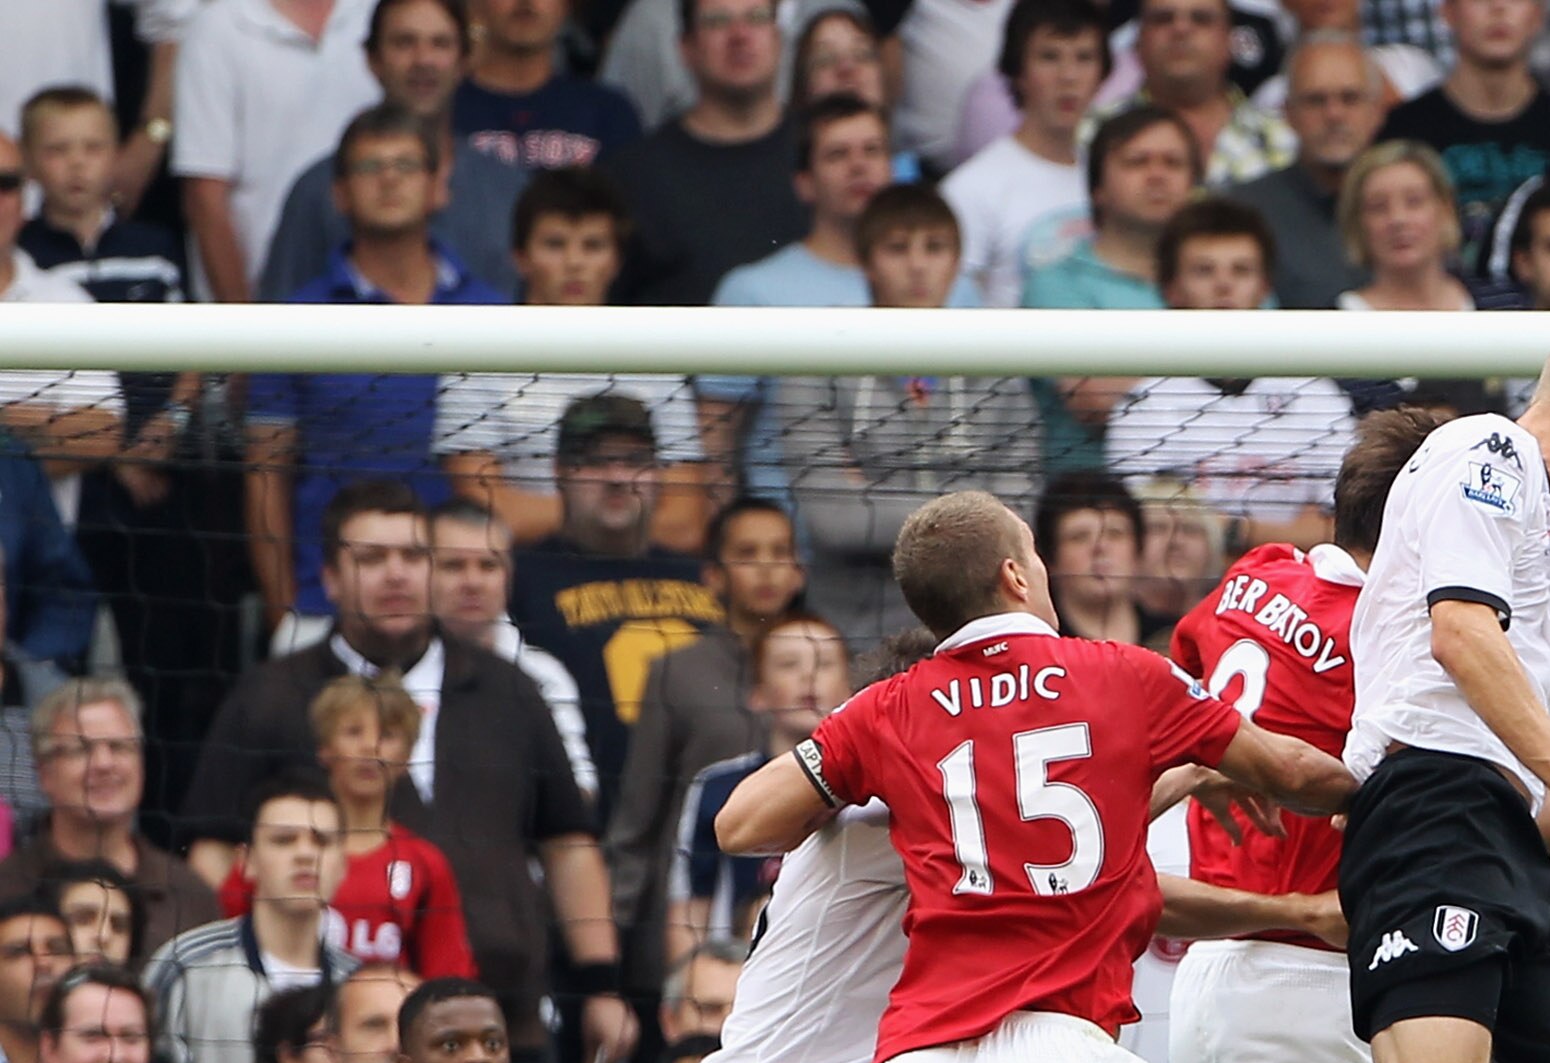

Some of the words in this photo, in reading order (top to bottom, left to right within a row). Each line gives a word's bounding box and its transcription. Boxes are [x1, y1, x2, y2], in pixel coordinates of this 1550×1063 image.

[1215, 574, 1346, 673] BERBATOV
[931, 664, 1066, 717] VIDIC
[937, 722, 1105, 897] 15
